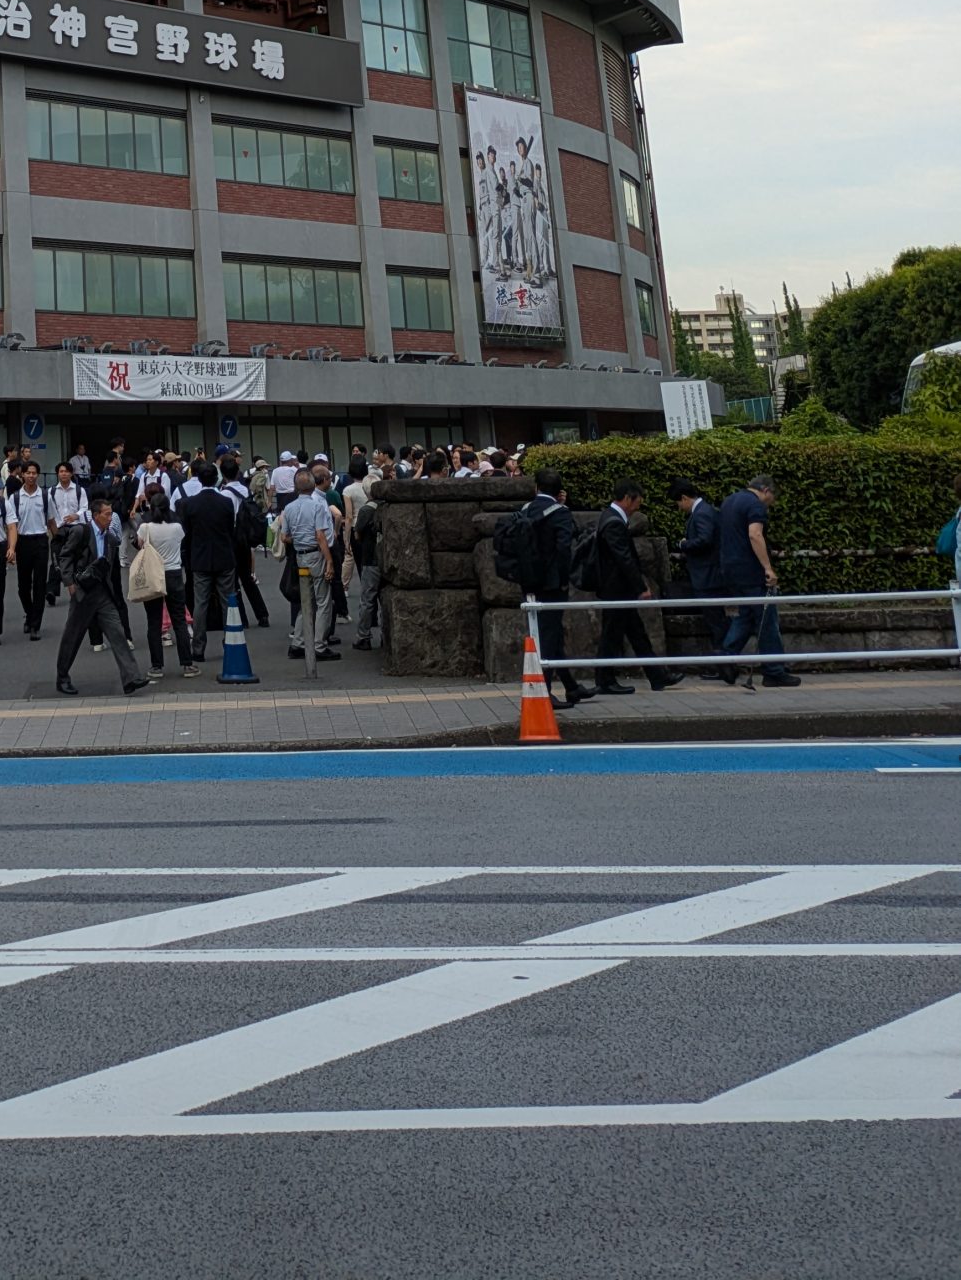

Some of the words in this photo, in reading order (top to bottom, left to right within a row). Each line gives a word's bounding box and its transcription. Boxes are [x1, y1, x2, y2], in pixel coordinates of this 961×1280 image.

[107, 360, 131, 392] 祝
[136, 360, 239, 377] 東京六大学野球連盟
[160, 381, 226, 398] 結成100周年
[29, 419, 39, 436] 7
[225, 420, 234, 436] 7
